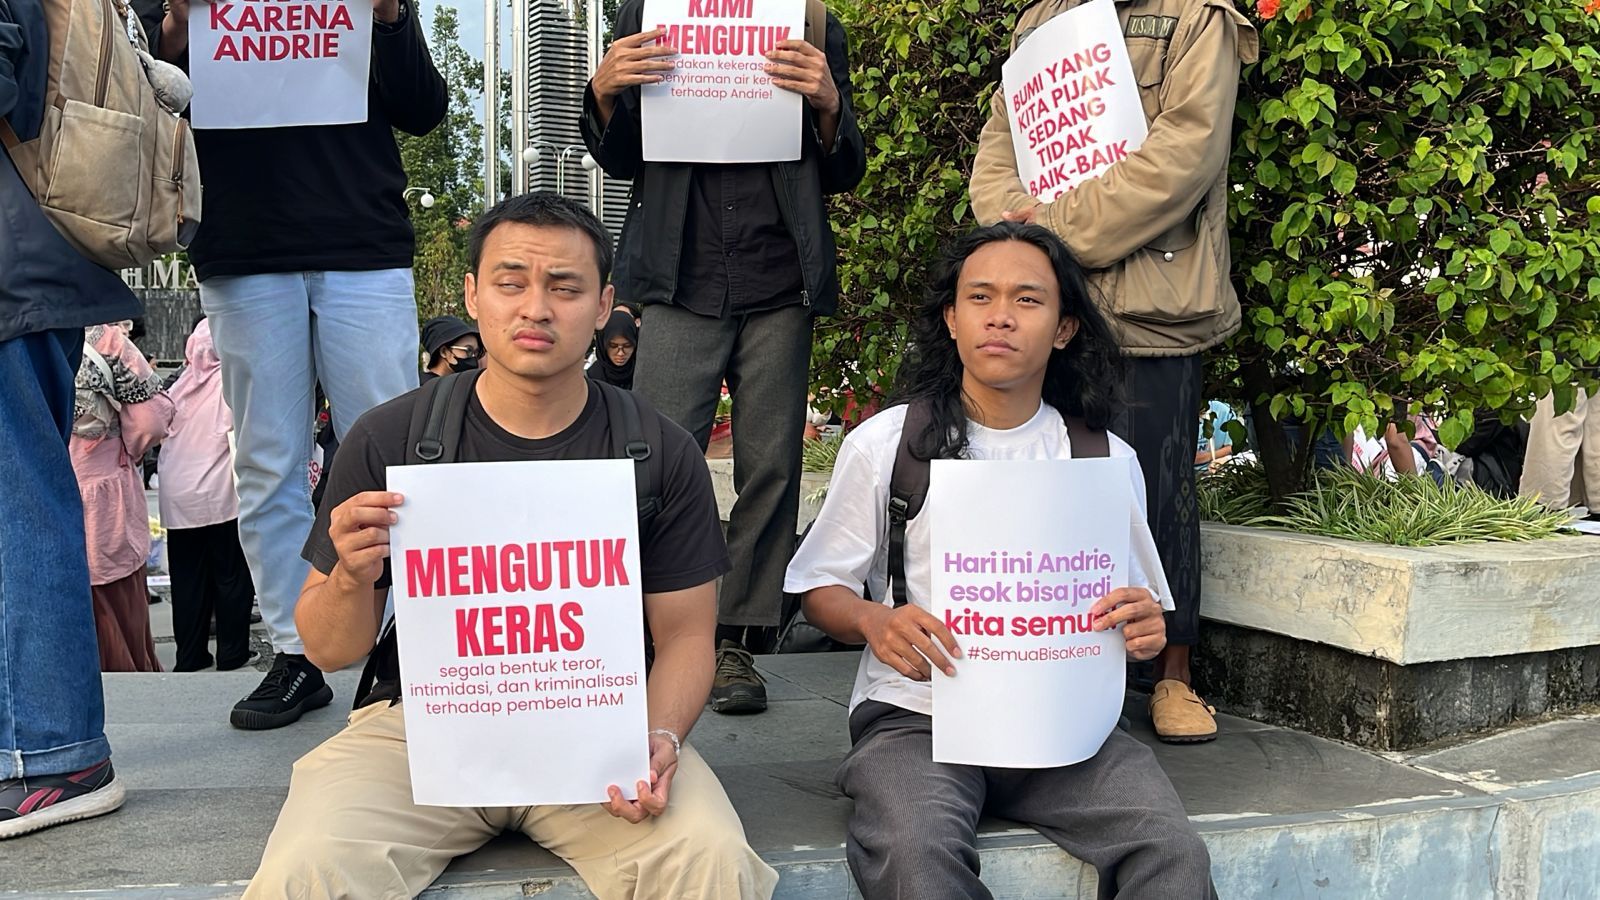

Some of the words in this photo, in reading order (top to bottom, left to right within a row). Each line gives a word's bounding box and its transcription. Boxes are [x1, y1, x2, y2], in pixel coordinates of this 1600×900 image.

[210, 3, 354, 32] KARENA
[688, 0, 754, 18] KAMI
[213, 33, 340, 61] ANDRIE
[661, 57, 714, 69] dakan
[734, 75, 749, 85] air
[753, 75, 786, 85] ker
[1013, 73, 1044, 114] BUMI
[1045, 42, 1112, 84] YANG
[671, 88, 728, 100] terhadap
[731, 89, 773, 99] Andrie!
[1018, 98, 1050, 134] KITA
[1051, 67, 1116, 108] PIJAK
[1028, 97, 1106, 149] SEDANG
[1037, 125, 1098, 167] TIDAK
[1029, 139, 1128, 198] BAIK-BAIK
[405, 538, 630, 598] MENGUTUK
[944, 551, 997, 573] Hari
[1002, 551, 1033, 574] ini
[1037, 548, 1116, 573] Andrie,
[950, 581, 1011, 603] esok
[1016, 579, 1068, 603] bisa
[1071, 575, 1111, 607] jadi
[455, 601, 585, 658] KERAS
[944, 608, 1004, 636] kita
[967, 644, 1101, 661] #SemuaBisaKena
[439, 663, 495, 681] segala
[500, 660, 558, 676] bentuk
[562, 657, 606, 672] teror,
[410, 682, 493, 698] intimidasi,
[497, 680, 530, 694] dan
[535, 672, 638, 692] kriminalisasi
[426, 697, 502, 716] terhadap
[507, 695, 582, 715] pembela
[586, 693, 624, 707] HAM
